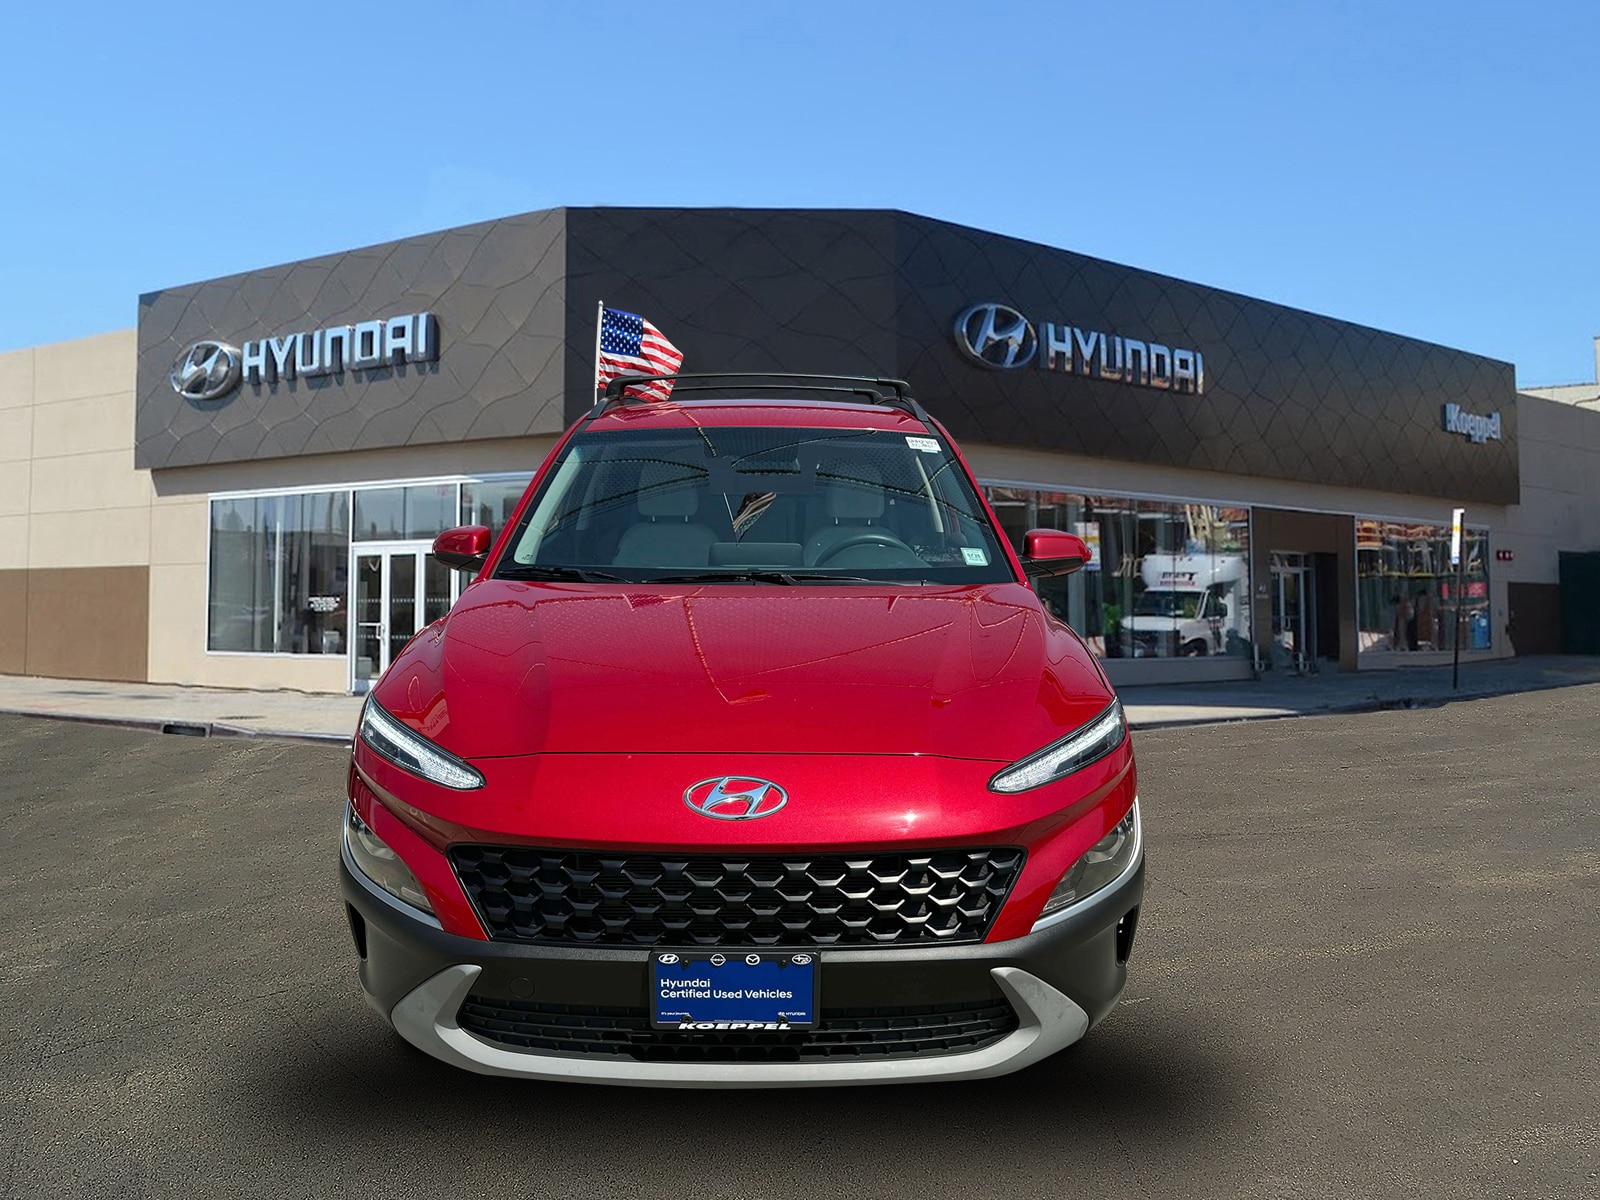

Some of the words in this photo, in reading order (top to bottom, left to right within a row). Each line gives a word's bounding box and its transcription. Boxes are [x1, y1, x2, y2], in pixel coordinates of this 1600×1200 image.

[242, 311, 430, 382] HYUNDAI
[1046, 321, 1205, 395] HYUNDAI
[1445, 403, 1501, 444] Koeppel
[660, 978, 711, 989] Hyundai
[660, 989, 711, 999] Certified
[713, 990, 743, 999] Used
[744, 989, 793, 999] Vehicles
[678, 1022, 791, 1030] KOEPPEL
